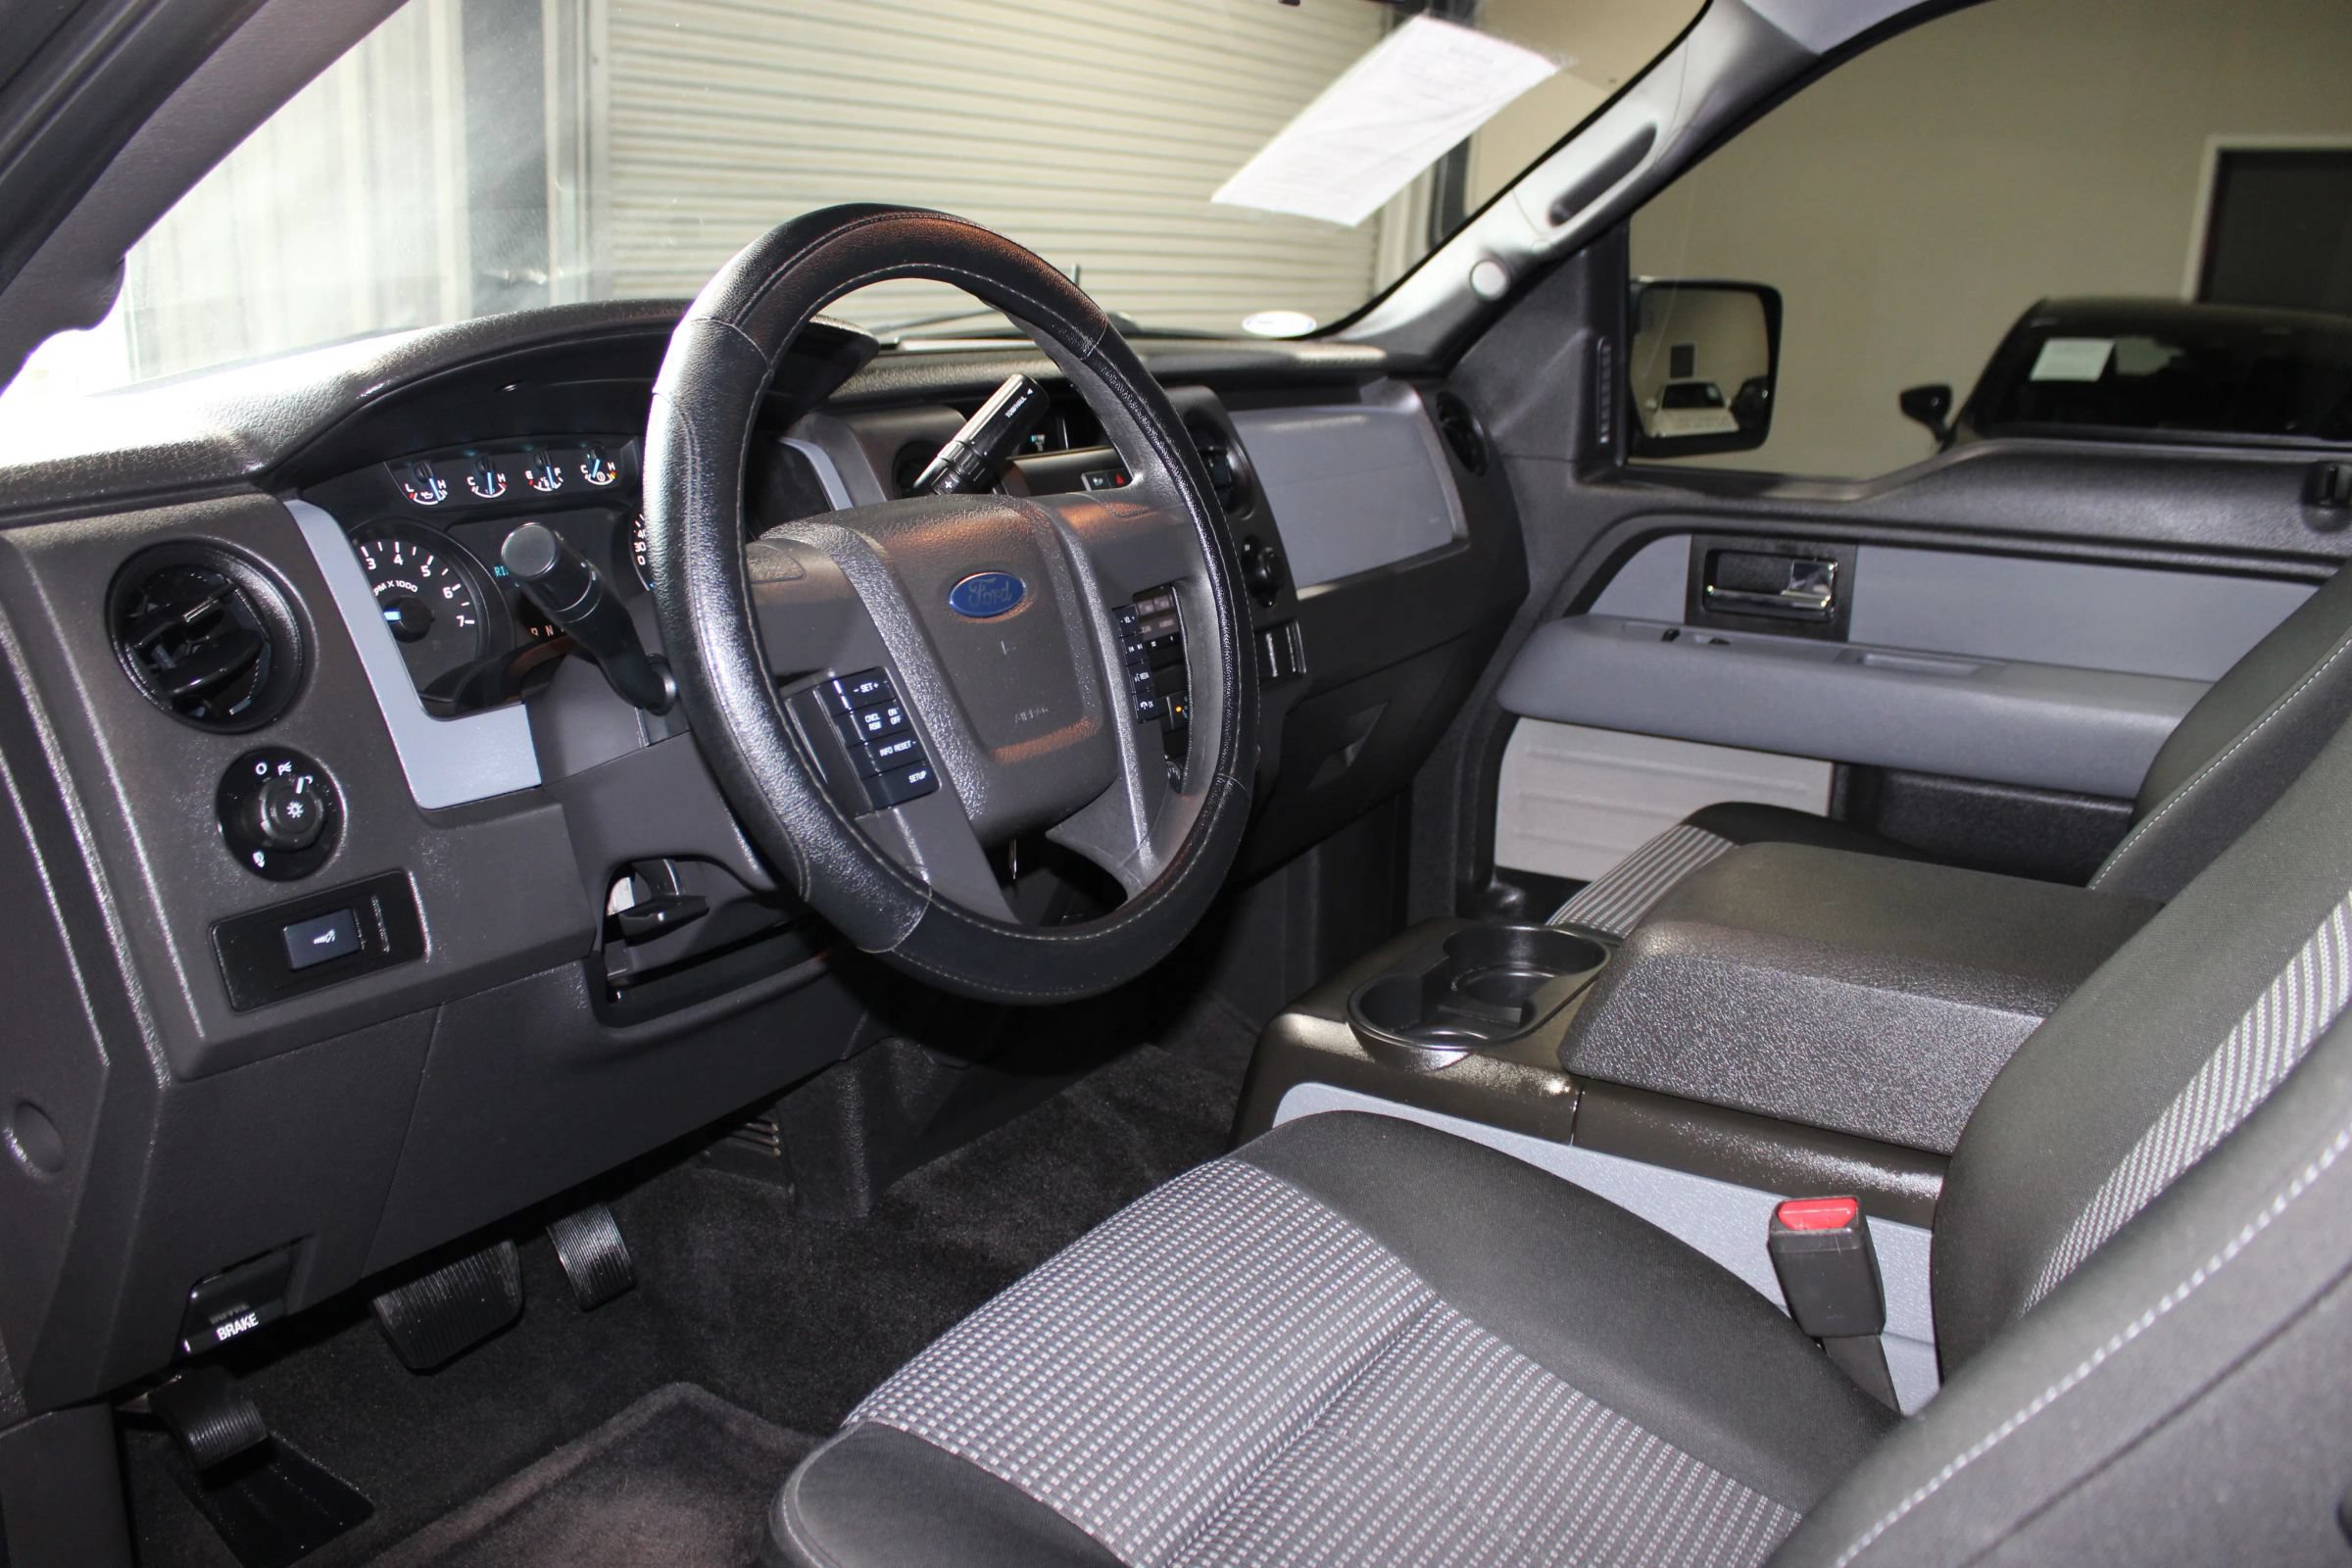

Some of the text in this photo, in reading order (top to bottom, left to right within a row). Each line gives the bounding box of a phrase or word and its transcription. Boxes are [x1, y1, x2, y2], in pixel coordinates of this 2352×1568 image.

[555, 467, 561, 476] F
[580, 465, 588, 473] C
[608, 462, 615, 470] H
[497, 473, 506, 482] H
[525, 470, 533, 479] E
[437, 479, 447, 489] H
[467, 476, 474, 486] C
[405, 483, 414, 493] L
[366, 558, 376, 570] 3
[394, 554, 404, 565] 4
[420, 564, 431, 577] 5
[396, 580, 418, 593] 1000
[968, 576, 1012, 607] Ford
[443, 587, 454, 599] 6
[456, 615, 465, 627] 7
[908, 770, 927, 783] SETUP
[217, 1312, 259, 1342] BRAKE
